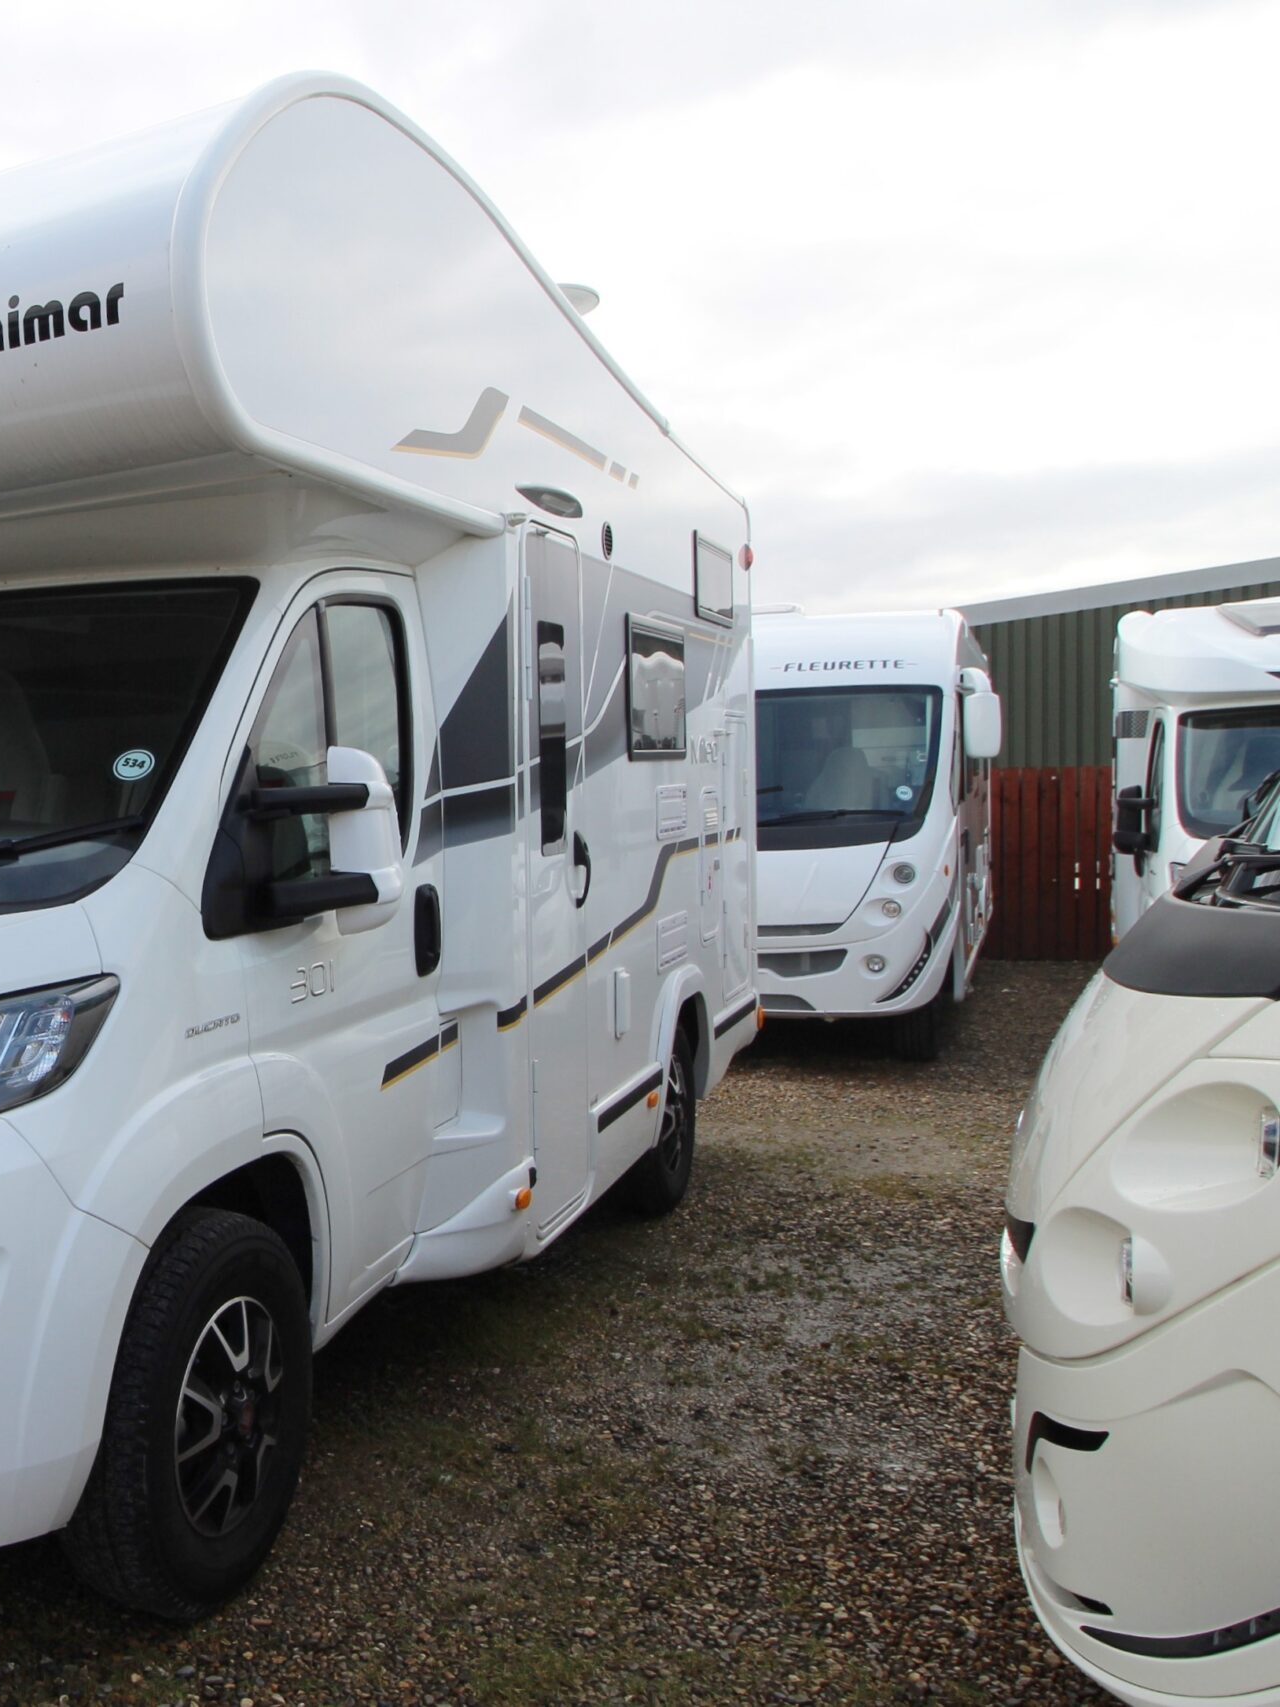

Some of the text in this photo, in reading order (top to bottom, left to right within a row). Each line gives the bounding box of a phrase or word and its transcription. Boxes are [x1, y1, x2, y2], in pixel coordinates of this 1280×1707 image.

[783, 659, 905, 672] FLEURETTE
[122, 757, 146, 769] 534
[289, 959, 335, 1004] 301
[185, 1013, 240, 1038] DUCATO
